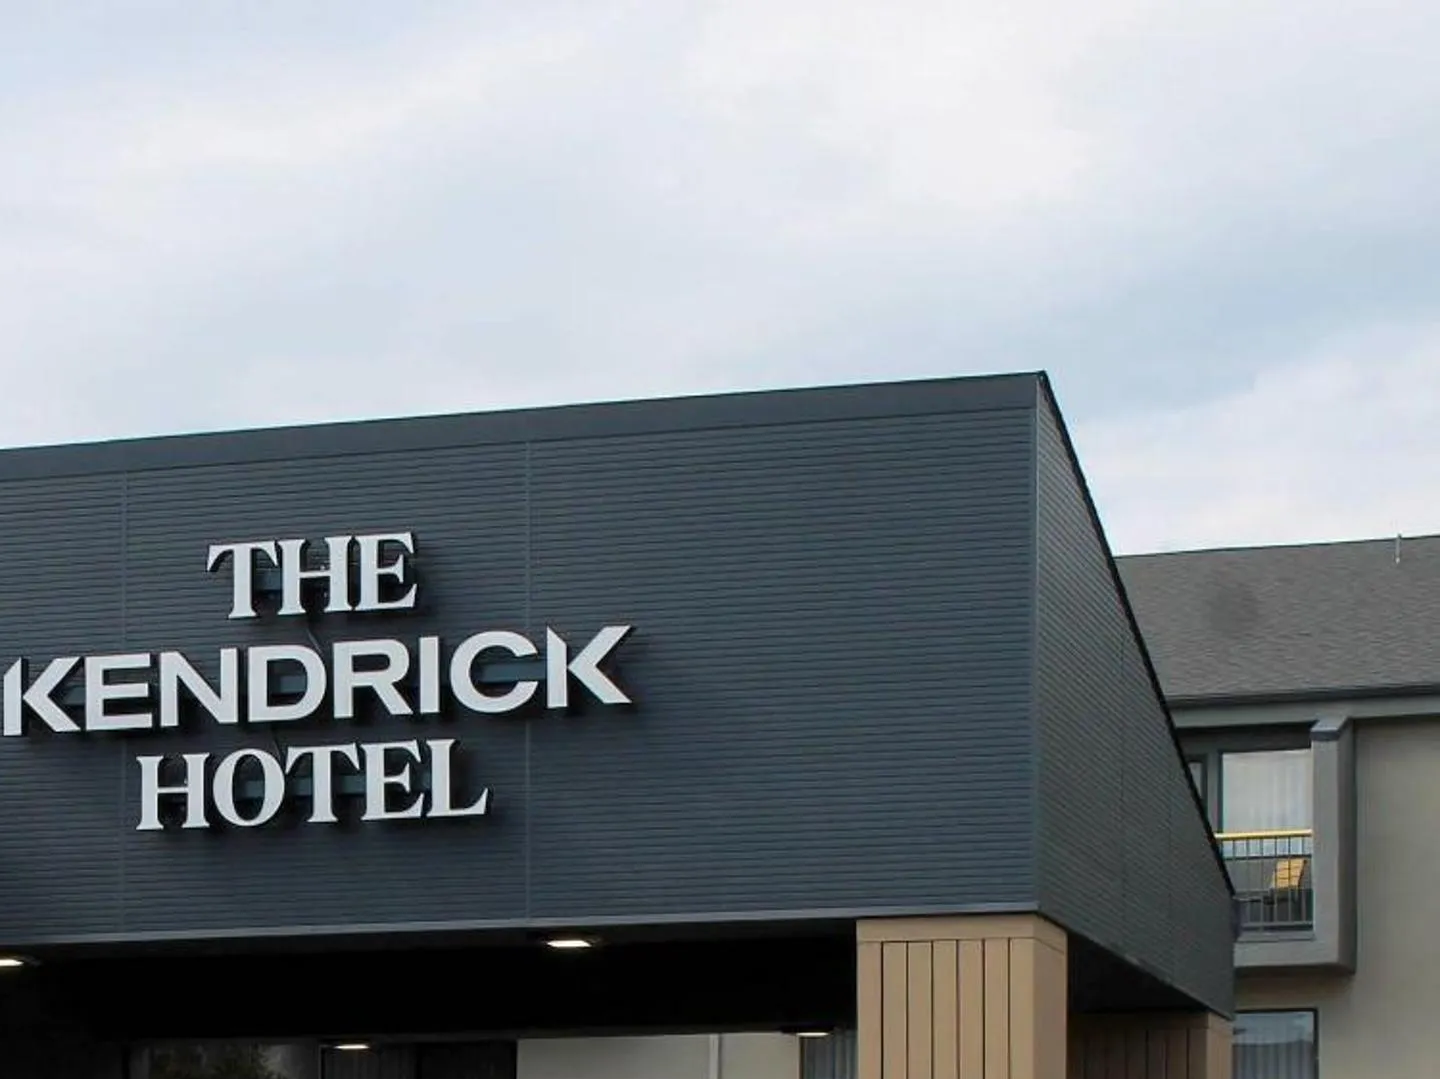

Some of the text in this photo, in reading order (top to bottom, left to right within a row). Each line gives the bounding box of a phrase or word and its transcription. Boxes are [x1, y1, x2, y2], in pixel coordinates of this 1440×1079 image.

[206, 531, 417, 619] THE
[3, 625, 632, 737] KENDRICK
[135, 738, 489, 831] HOTEL
